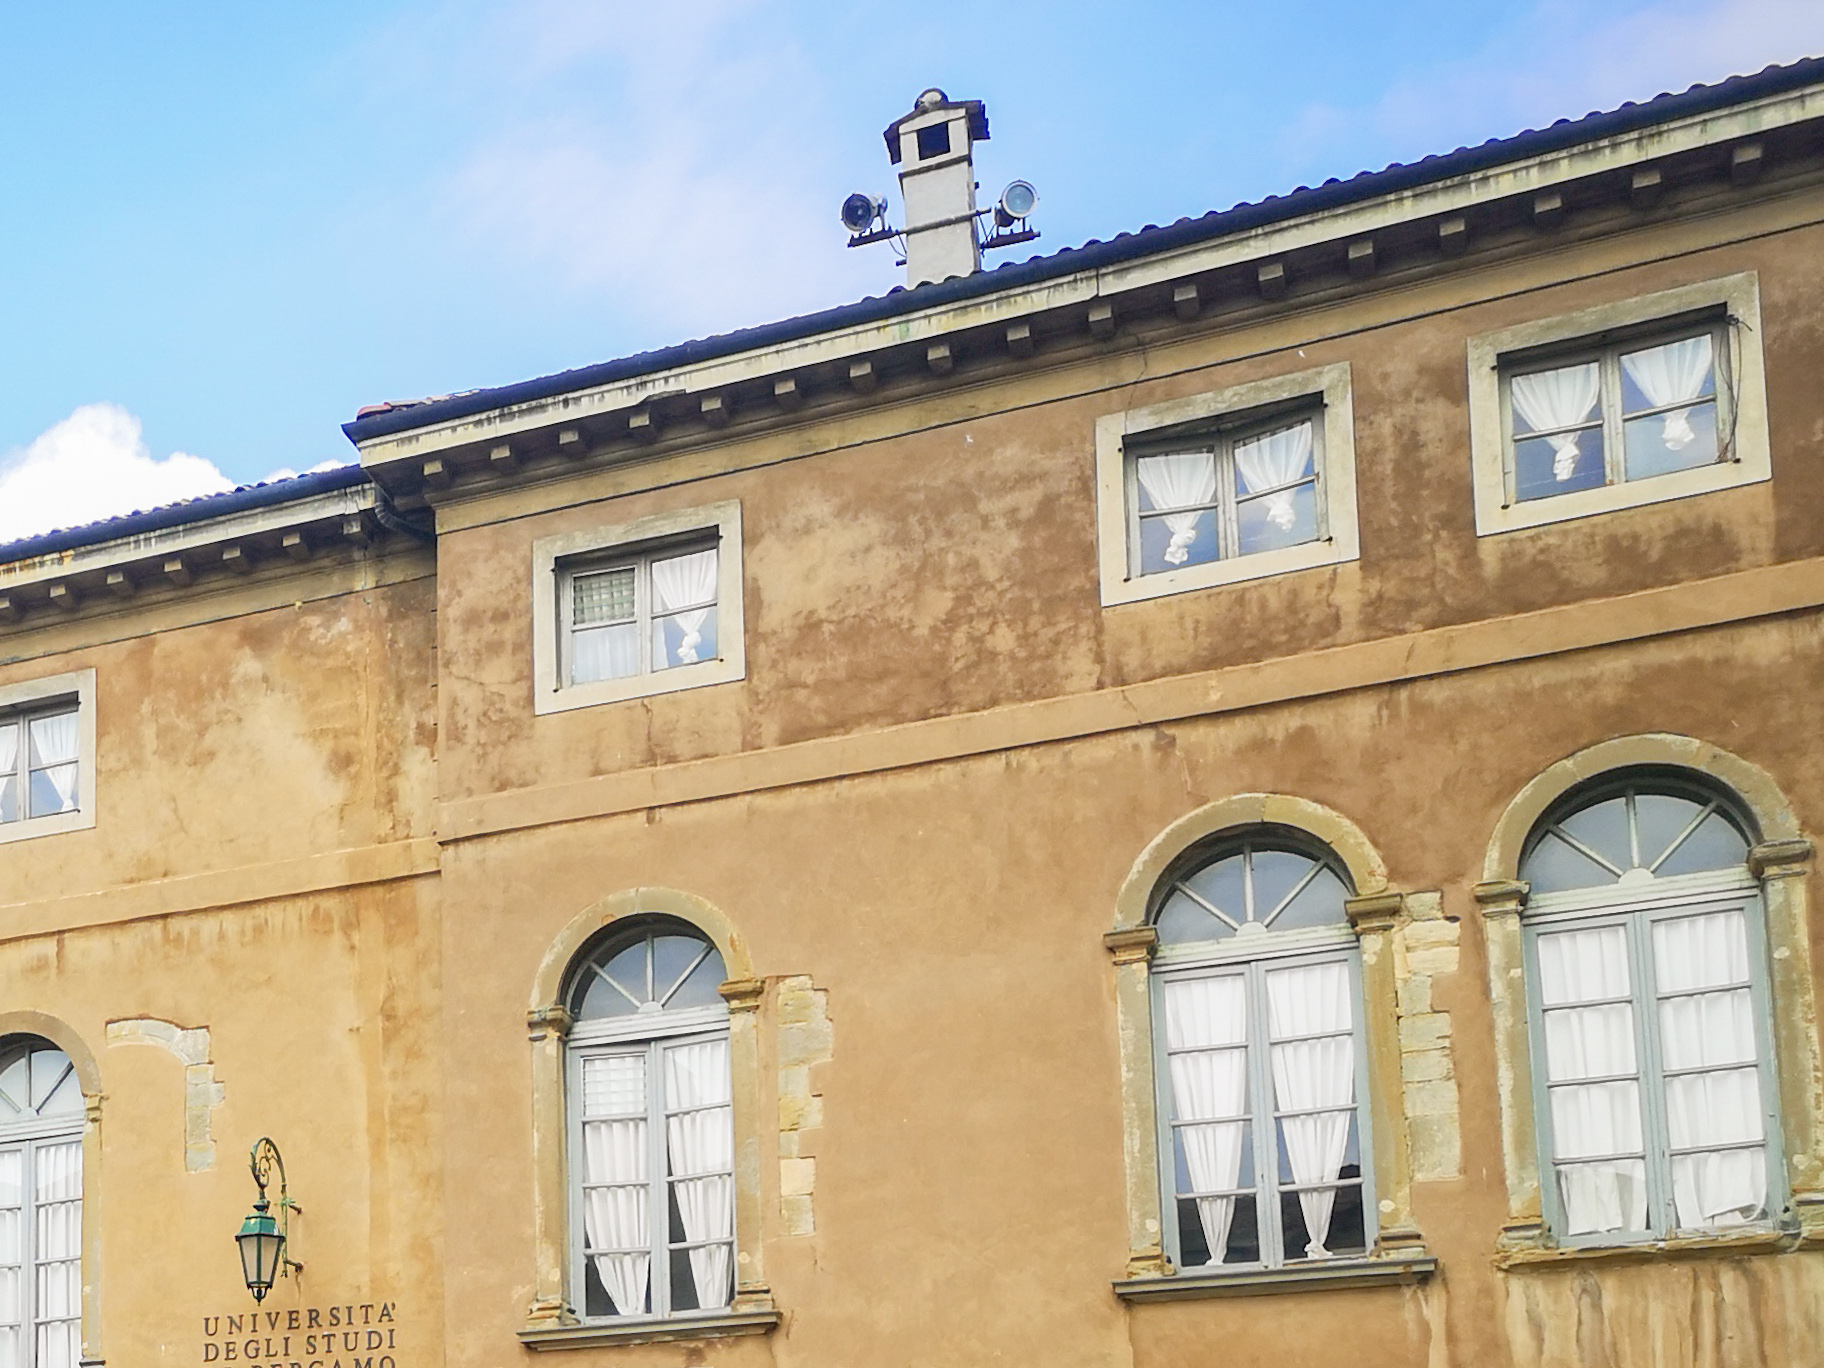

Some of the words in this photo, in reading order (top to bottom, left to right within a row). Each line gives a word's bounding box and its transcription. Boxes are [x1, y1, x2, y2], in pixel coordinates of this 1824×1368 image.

[204, 1302, 396, 1337] UNIVERSITA'
[204, 1337, 291, 1362] DEGLI
[305, 1328, 396, 1355] STUDI
